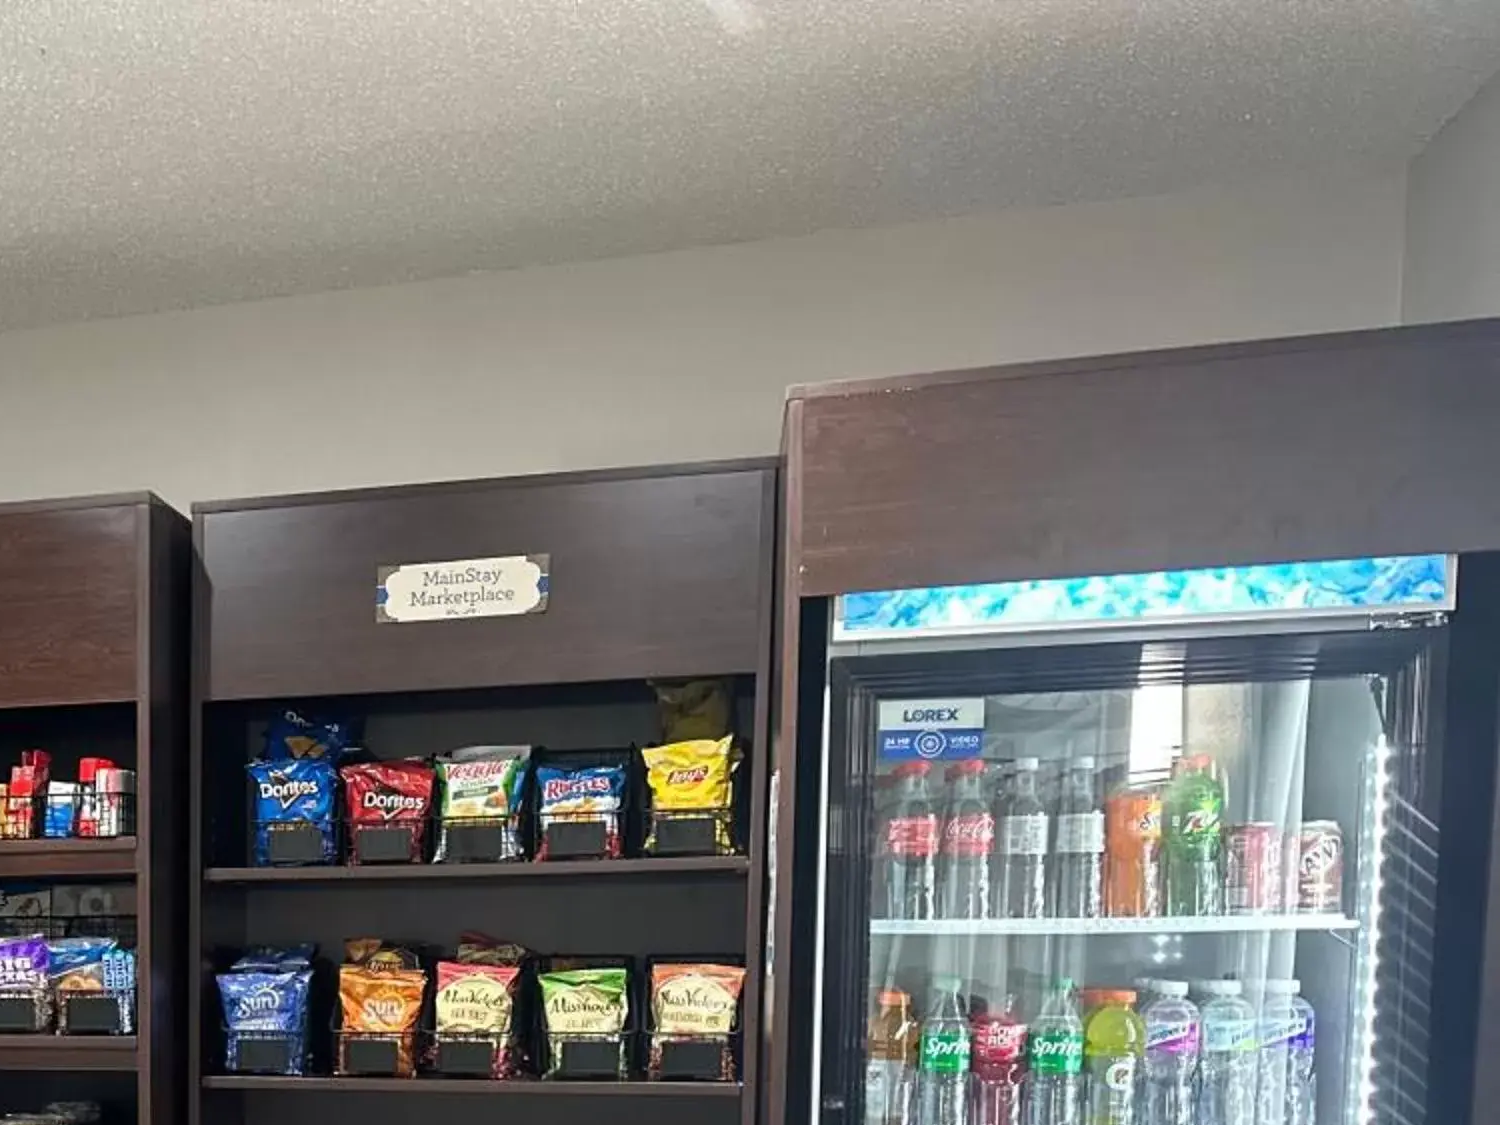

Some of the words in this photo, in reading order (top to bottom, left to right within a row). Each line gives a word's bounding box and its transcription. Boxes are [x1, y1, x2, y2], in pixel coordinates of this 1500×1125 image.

[423, 566, 502, 587] MainStay
[411, 586, 515, 608] Marketplace
[903, 708, 959, 722] LOREX
[260, 780, 318, 800] Doritos
[363, 791, 424, 812] Doritos
